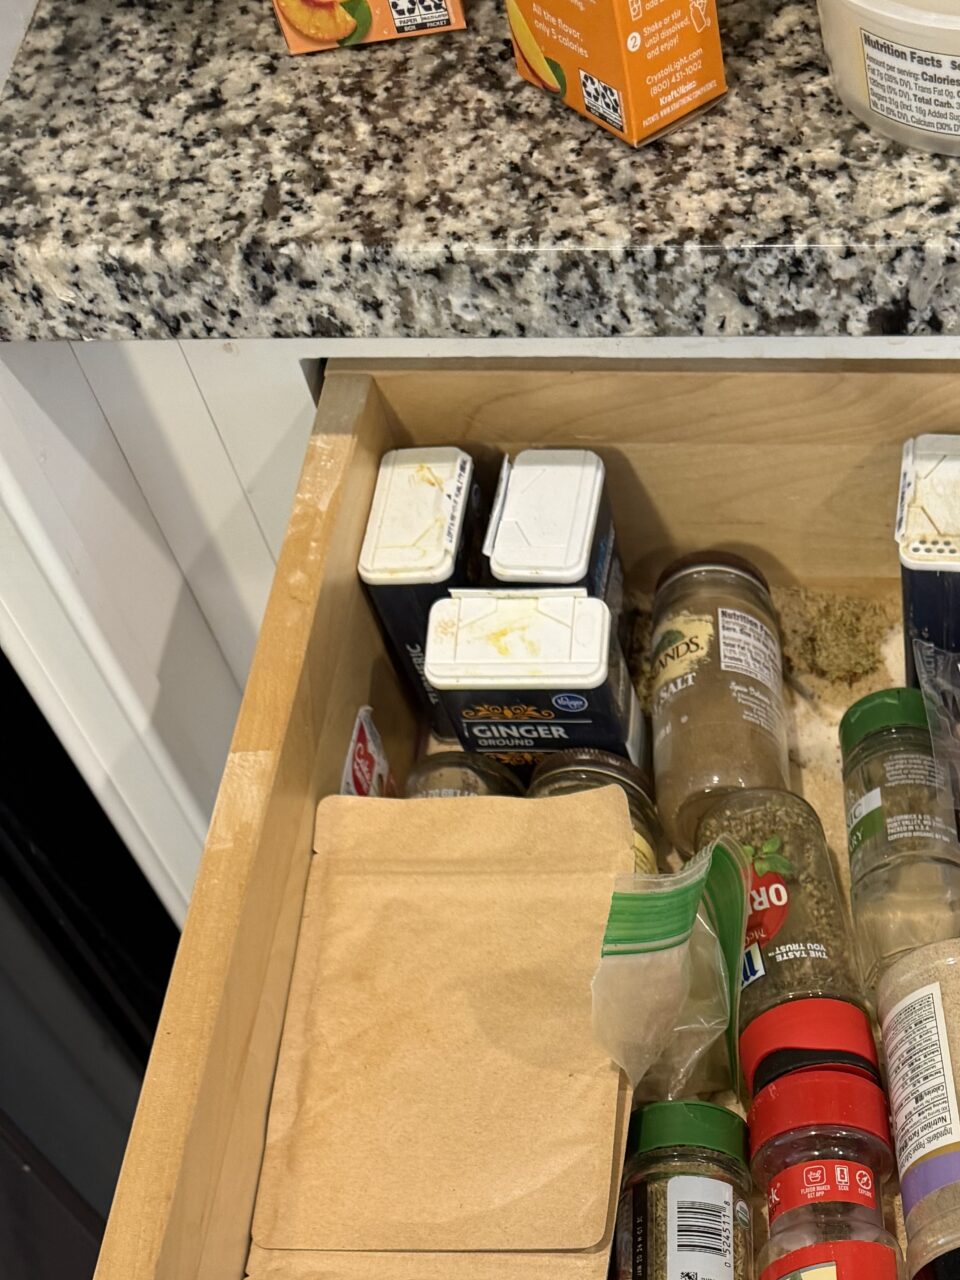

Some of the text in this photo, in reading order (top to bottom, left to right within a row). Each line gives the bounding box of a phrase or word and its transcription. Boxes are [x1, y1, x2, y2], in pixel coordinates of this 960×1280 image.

[534, 20, 551, 35] only
[558, 32, 589, 58] calories
[864, 33, 907, 60] Nutrition
[910, 51, 942, 68] Facts
[921, 72, 960, 86] Calories
[659, 672, 696, 702] SALT
[473, 724, 569, 739] GINGER
[479, 738, 534, 747] GROUND
[776, 951, 827, 962] THE TASTE
